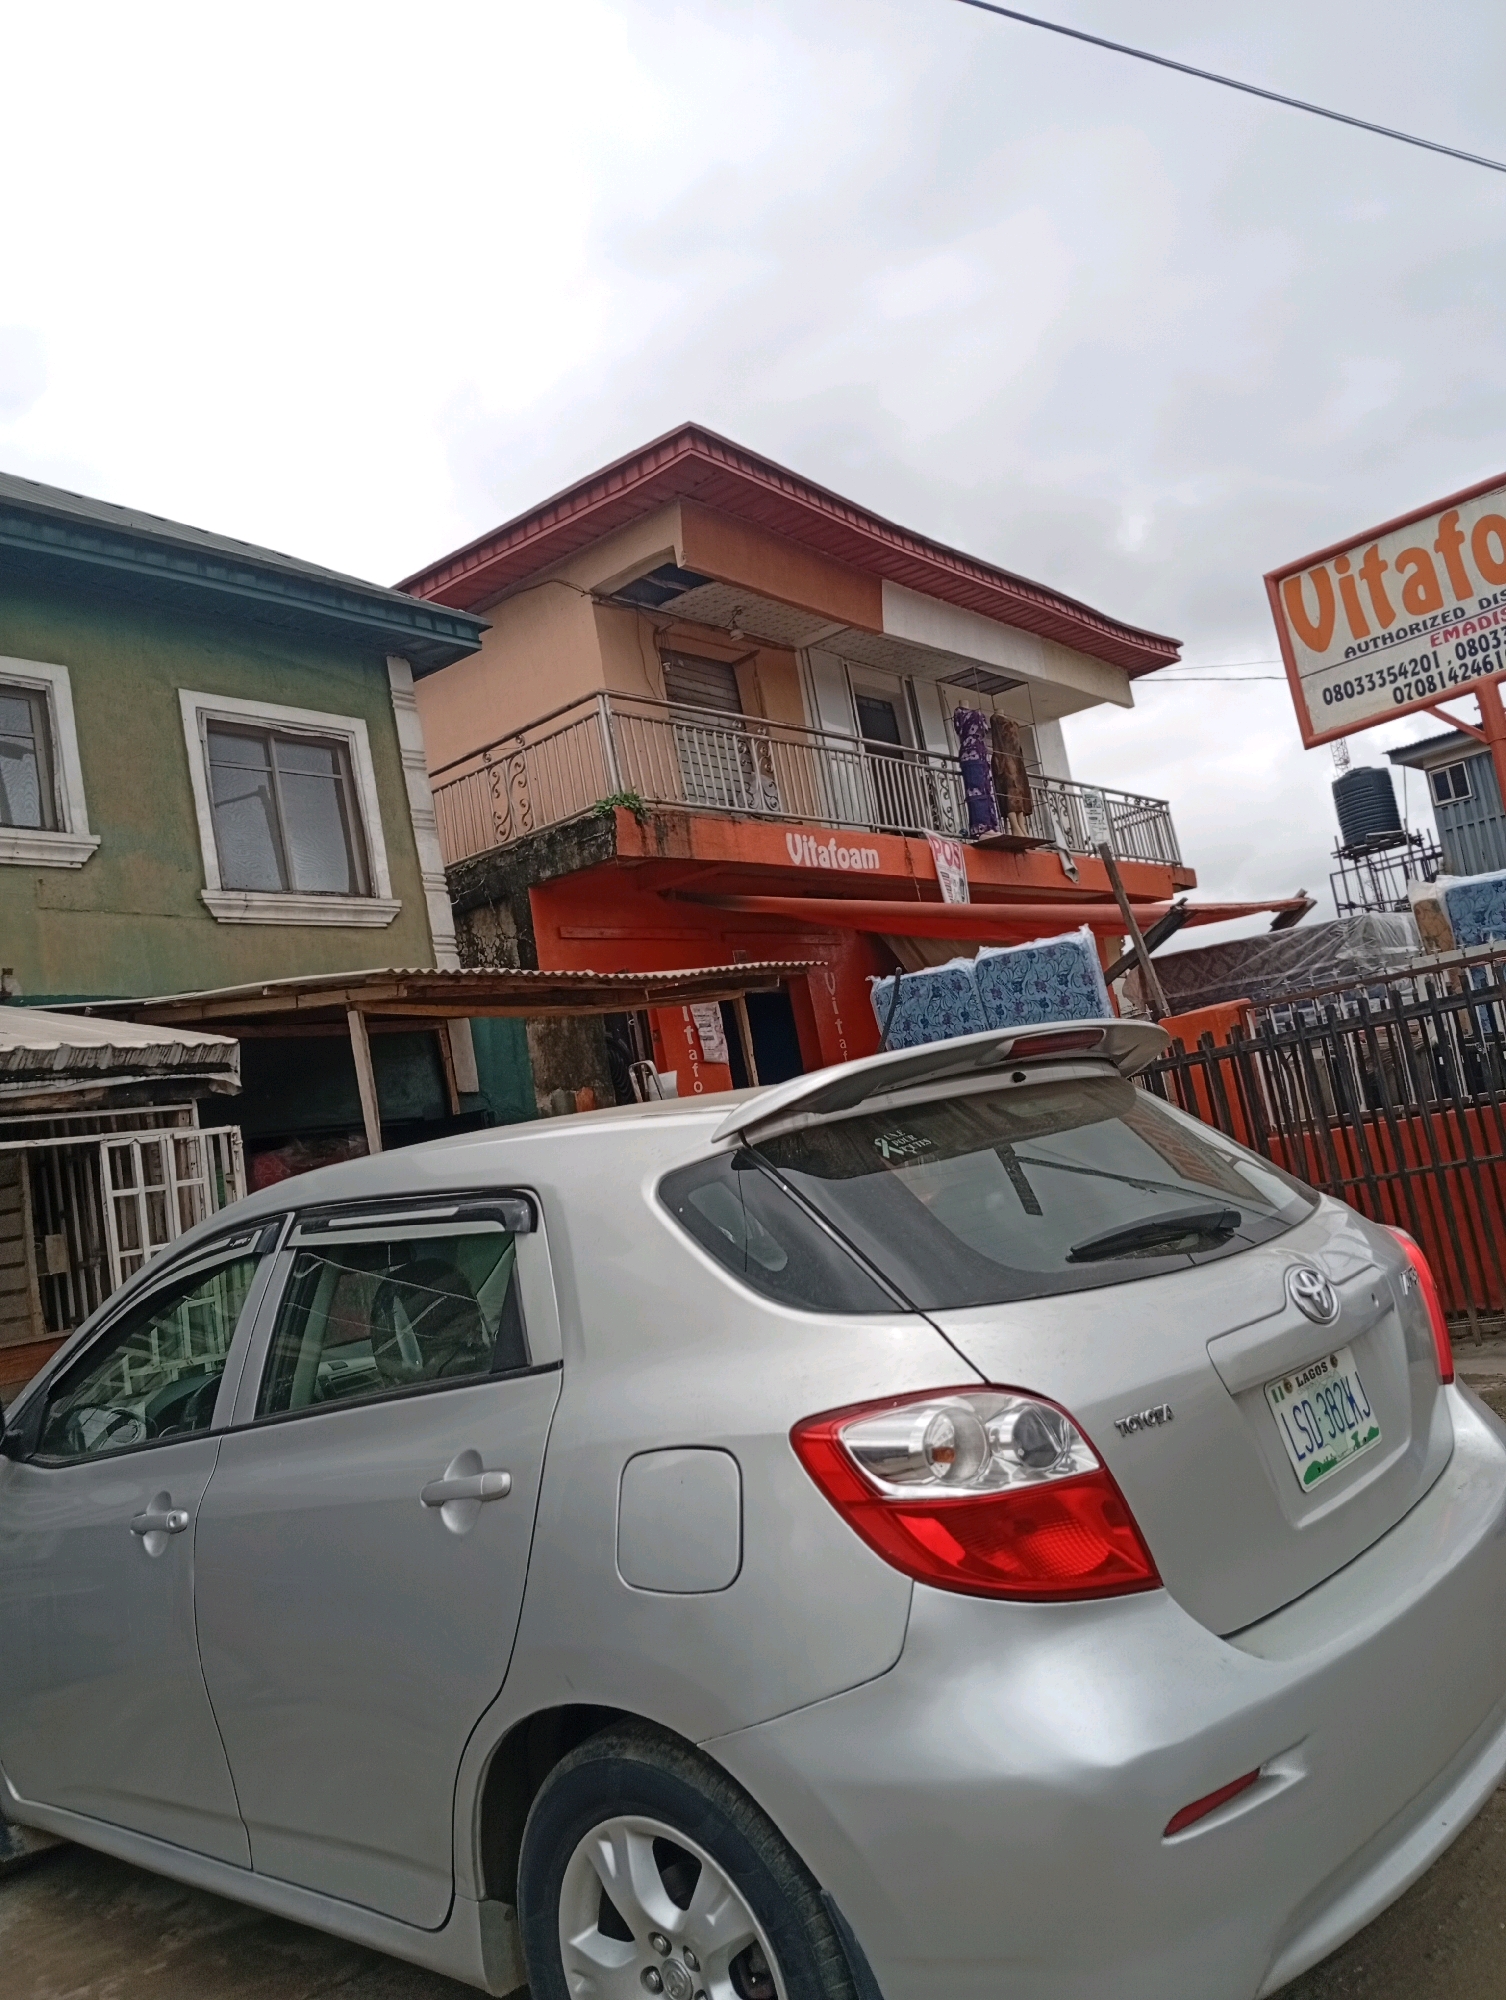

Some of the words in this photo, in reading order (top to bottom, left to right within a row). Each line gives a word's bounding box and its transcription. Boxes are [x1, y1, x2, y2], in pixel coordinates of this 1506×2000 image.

[1283, 509, 1506, 652] Vitafo
[1344, 606, 1466, 659] AUTHORIZED
[1392, 649, 1506, 705] 0708142461
[785, 832, 880, 870] Vitafoam
[929, 836, 962, 871] POS
[1295, 1361, 1329, 1388] LAGOS
[1114, 1403, 1175, 1438] TOYOTA
